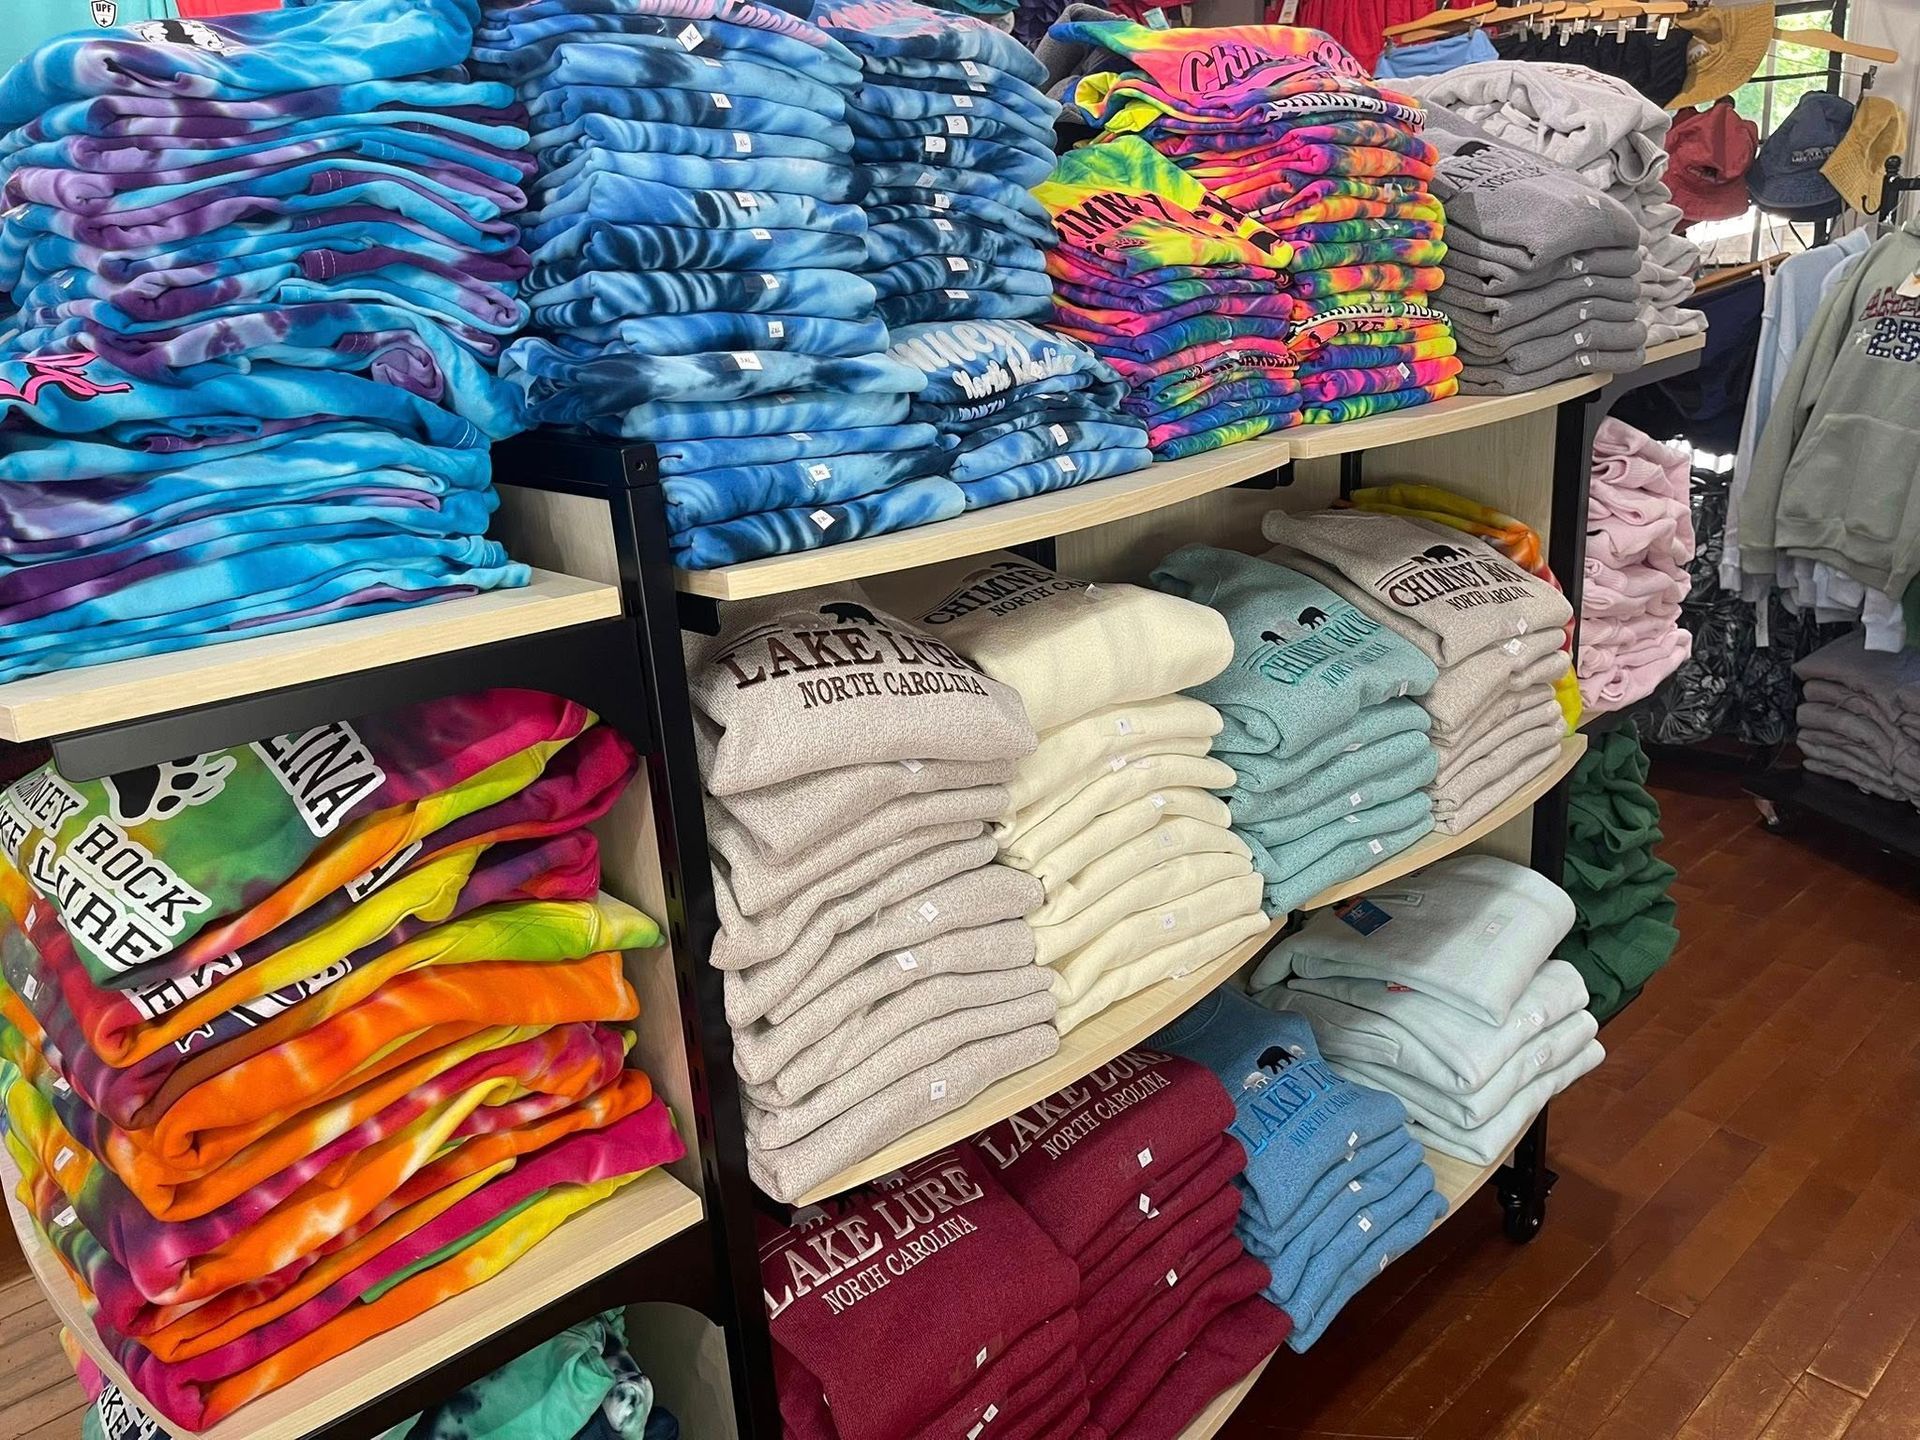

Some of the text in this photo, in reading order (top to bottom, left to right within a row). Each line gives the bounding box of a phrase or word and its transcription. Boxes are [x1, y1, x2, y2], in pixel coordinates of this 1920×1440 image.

[95, 3, 111, 12] UPF
[923, 568, 1055, 625] CHIMNE
[988, 585, 1056, 617] NORTH
[1389, 561, 1490, 607] CHIMNEY
[716, 627, 984, 690] LAKE LUR
[798, 671, 989, 709] NORTH CAROLINA
[33, 845, 163, 967] LURE
[73, 822, 202, 926] ROCK
[979, 1086, 1092, 1170] LAKE
[1041, 1071, 1171, 1160] NORTH CAROLINA
[1228, 1073, 1318, 1157] LAKE
[763, 1165, 984, 1320] LAKE LURE
[821, 1214, 978, 1315] NORTH CAROLINA
